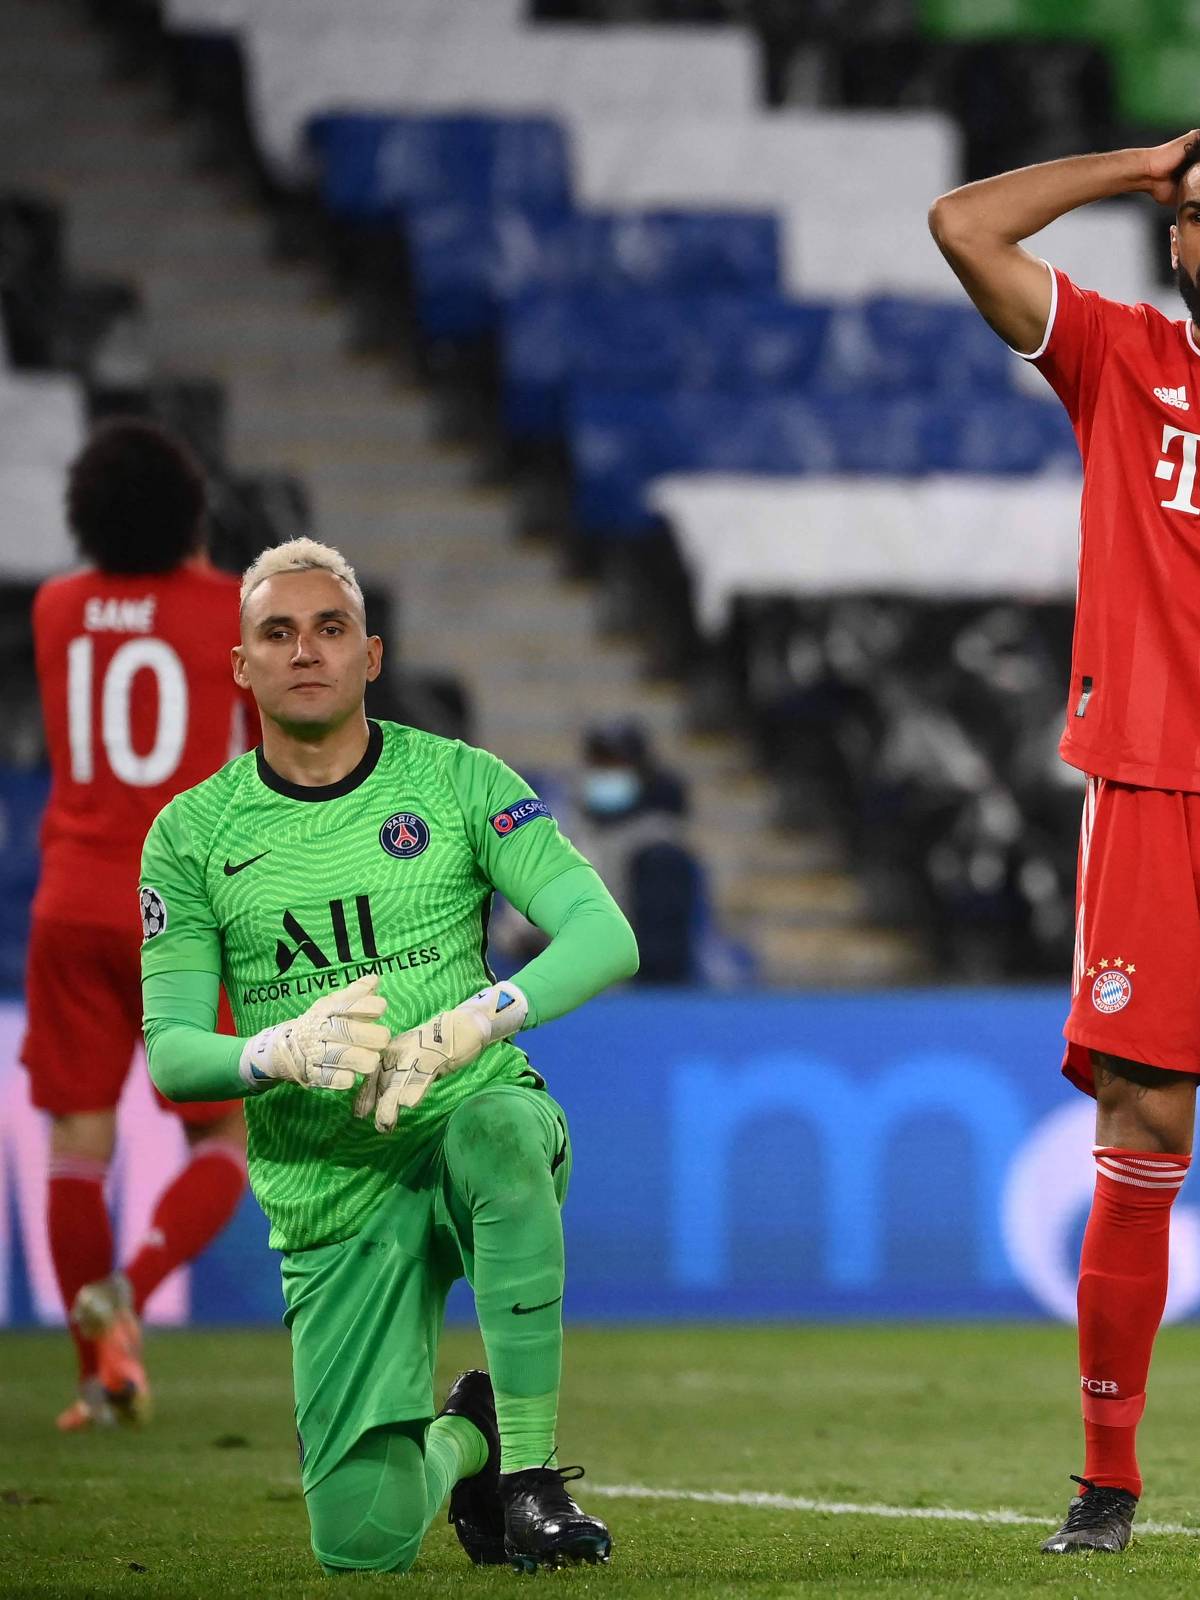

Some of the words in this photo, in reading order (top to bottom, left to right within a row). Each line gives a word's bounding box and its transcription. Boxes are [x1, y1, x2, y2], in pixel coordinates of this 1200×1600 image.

[67, 635, 189, 788] 10
[386, 815, 417, 830] PARIS
[243, 982, 292, 1006] ACCOR
[296, 971, 340, 995] LIVE
[345, 946, 441, 985] LIMITLESS
[1102, 973, 1128, 989] BAYERN
[1080, 1375, 1119, 1394] FCB
